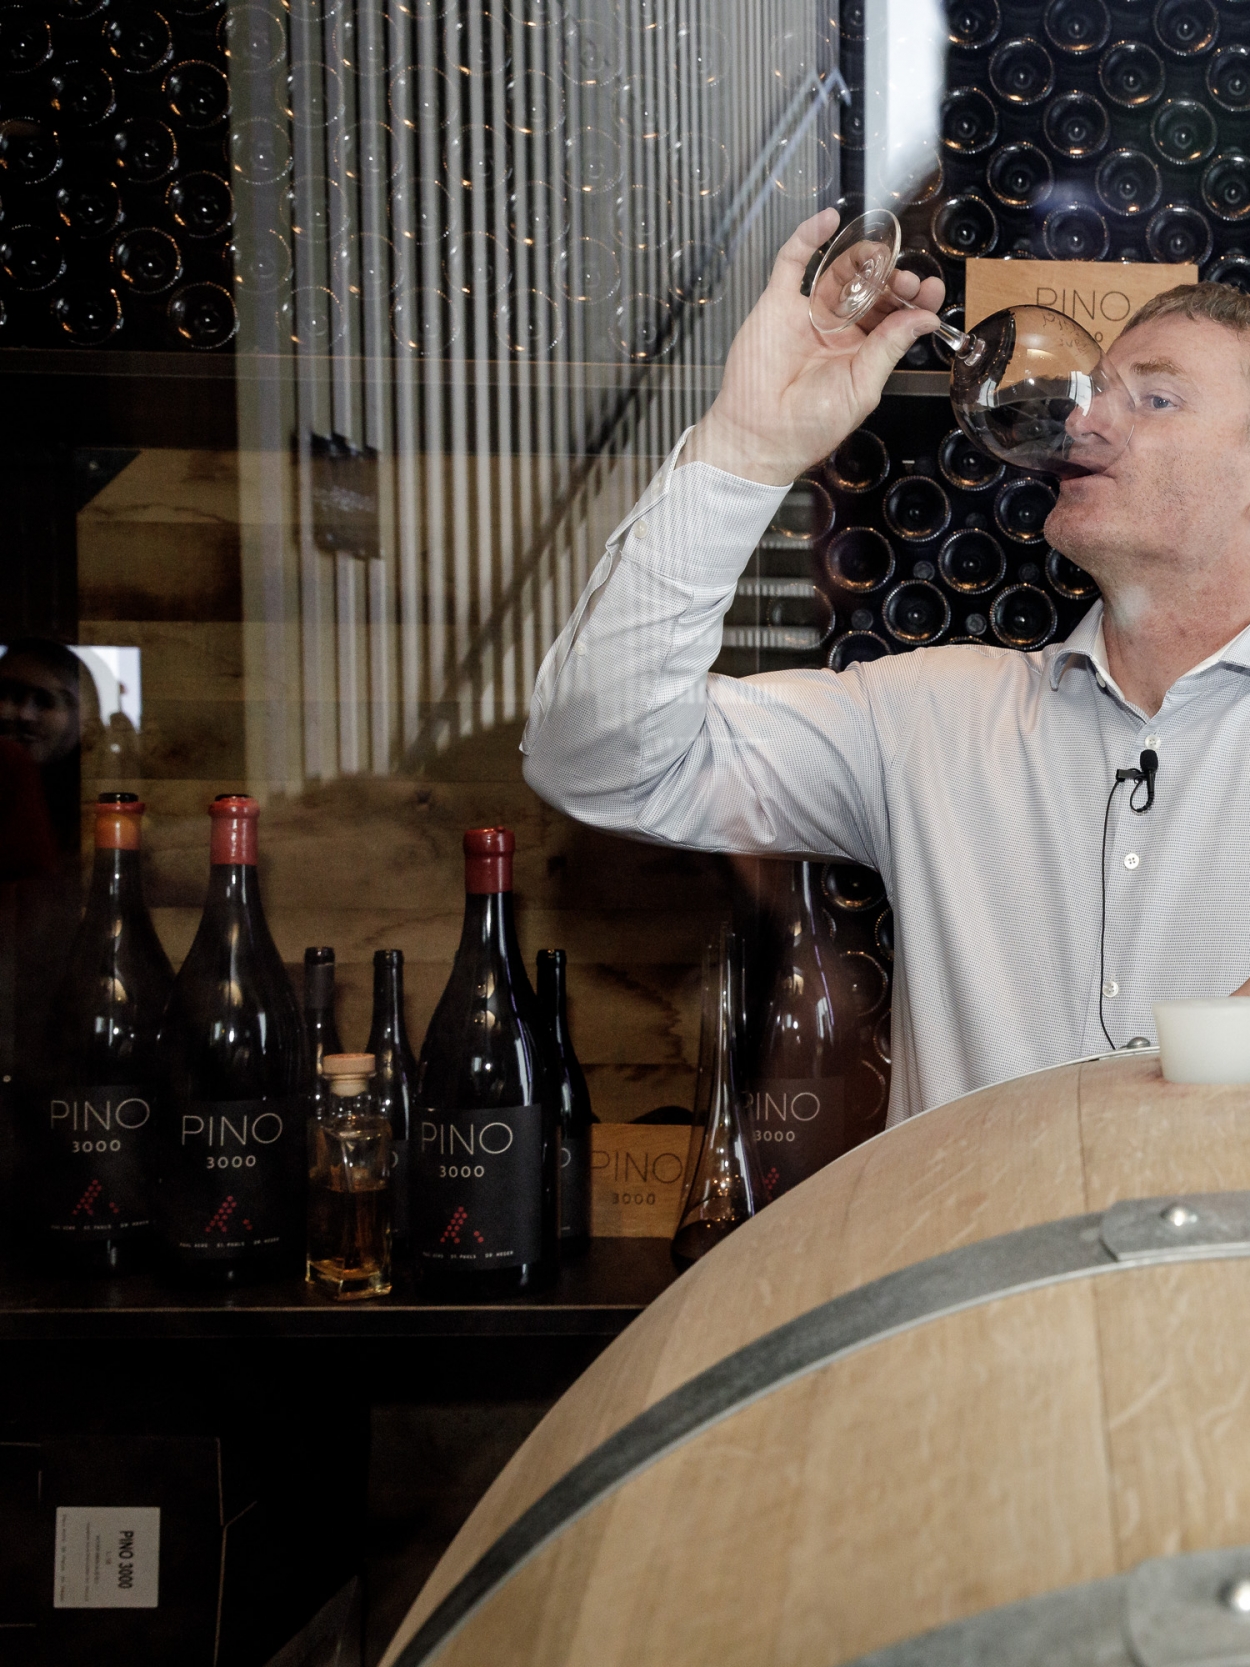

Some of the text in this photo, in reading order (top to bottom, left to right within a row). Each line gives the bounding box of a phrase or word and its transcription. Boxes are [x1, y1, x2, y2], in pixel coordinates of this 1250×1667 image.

[1036, 287, 1131, 322] PINO
[50, 1097, 151, 1132] PINO
[181, 1112, 283, 1147] PINO
[71, 1139, 121, 1154] 3000
[421, 1121, 513, 1156] PINO
[754, 1129, 796, 1143] 3000
[206, 1154, 256, 1170] 3000
[439, 1165, 485, 1179] 3000
[591, 1150, 683, 1184] PINO
[612, 1192, 656, 1206] 3000
[118, 1530, 134, 1589] PINO 3000
